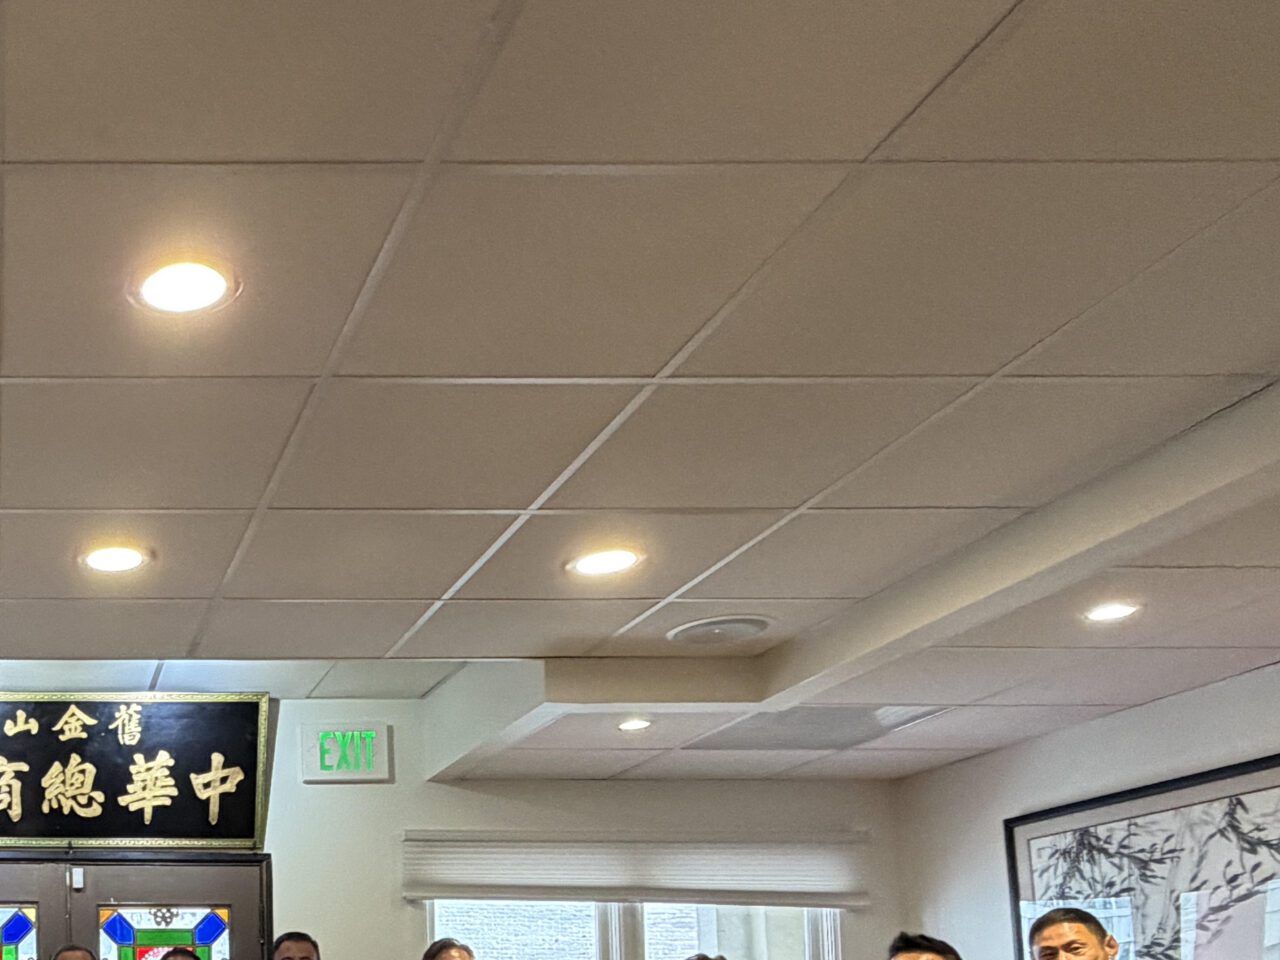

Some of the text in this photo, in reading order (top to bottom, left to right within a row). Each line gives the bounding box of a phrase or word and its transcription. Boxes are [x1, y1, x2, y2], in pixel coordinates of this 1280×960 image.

[4, 704, 143, 746] 舊金山
[319, 730, 377, 772] EXIT
